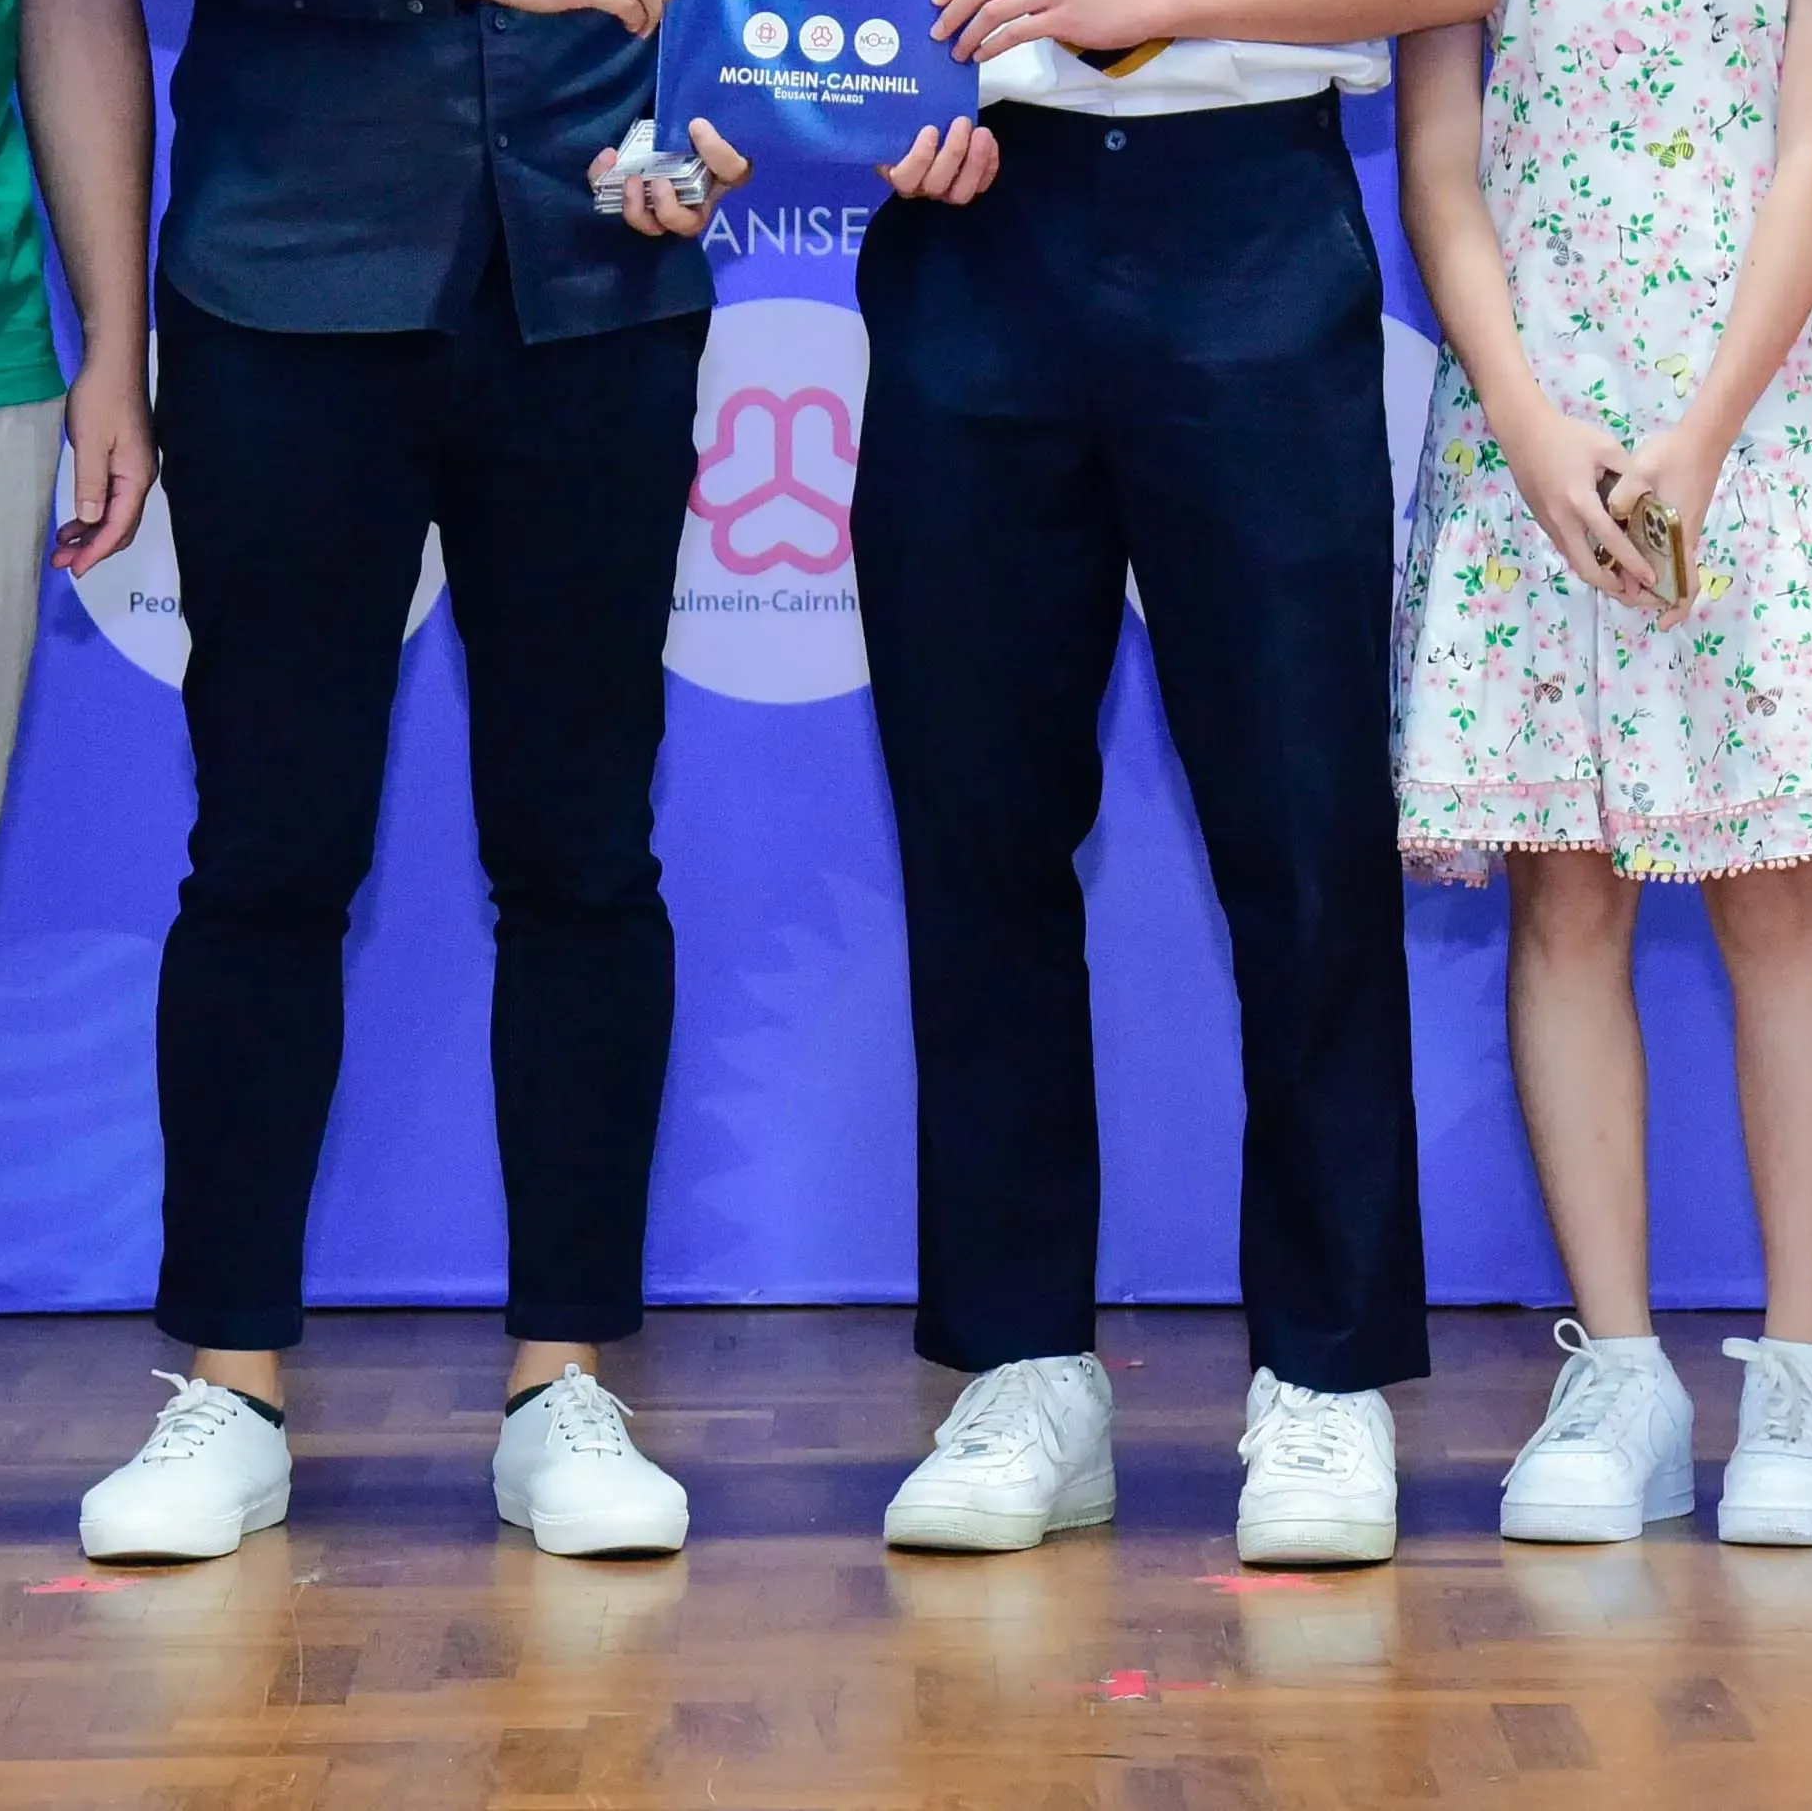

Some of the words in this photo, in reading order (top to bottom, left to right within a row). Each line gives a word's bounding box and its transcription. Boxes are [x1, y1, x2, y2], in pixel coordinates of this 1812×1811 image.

[719, 66, 920, 95] MOULMEIN-CAIRNHILL
[774, 87, 818, 102] EDUSAVE
[821, 89, 865, 105] AWARDS
